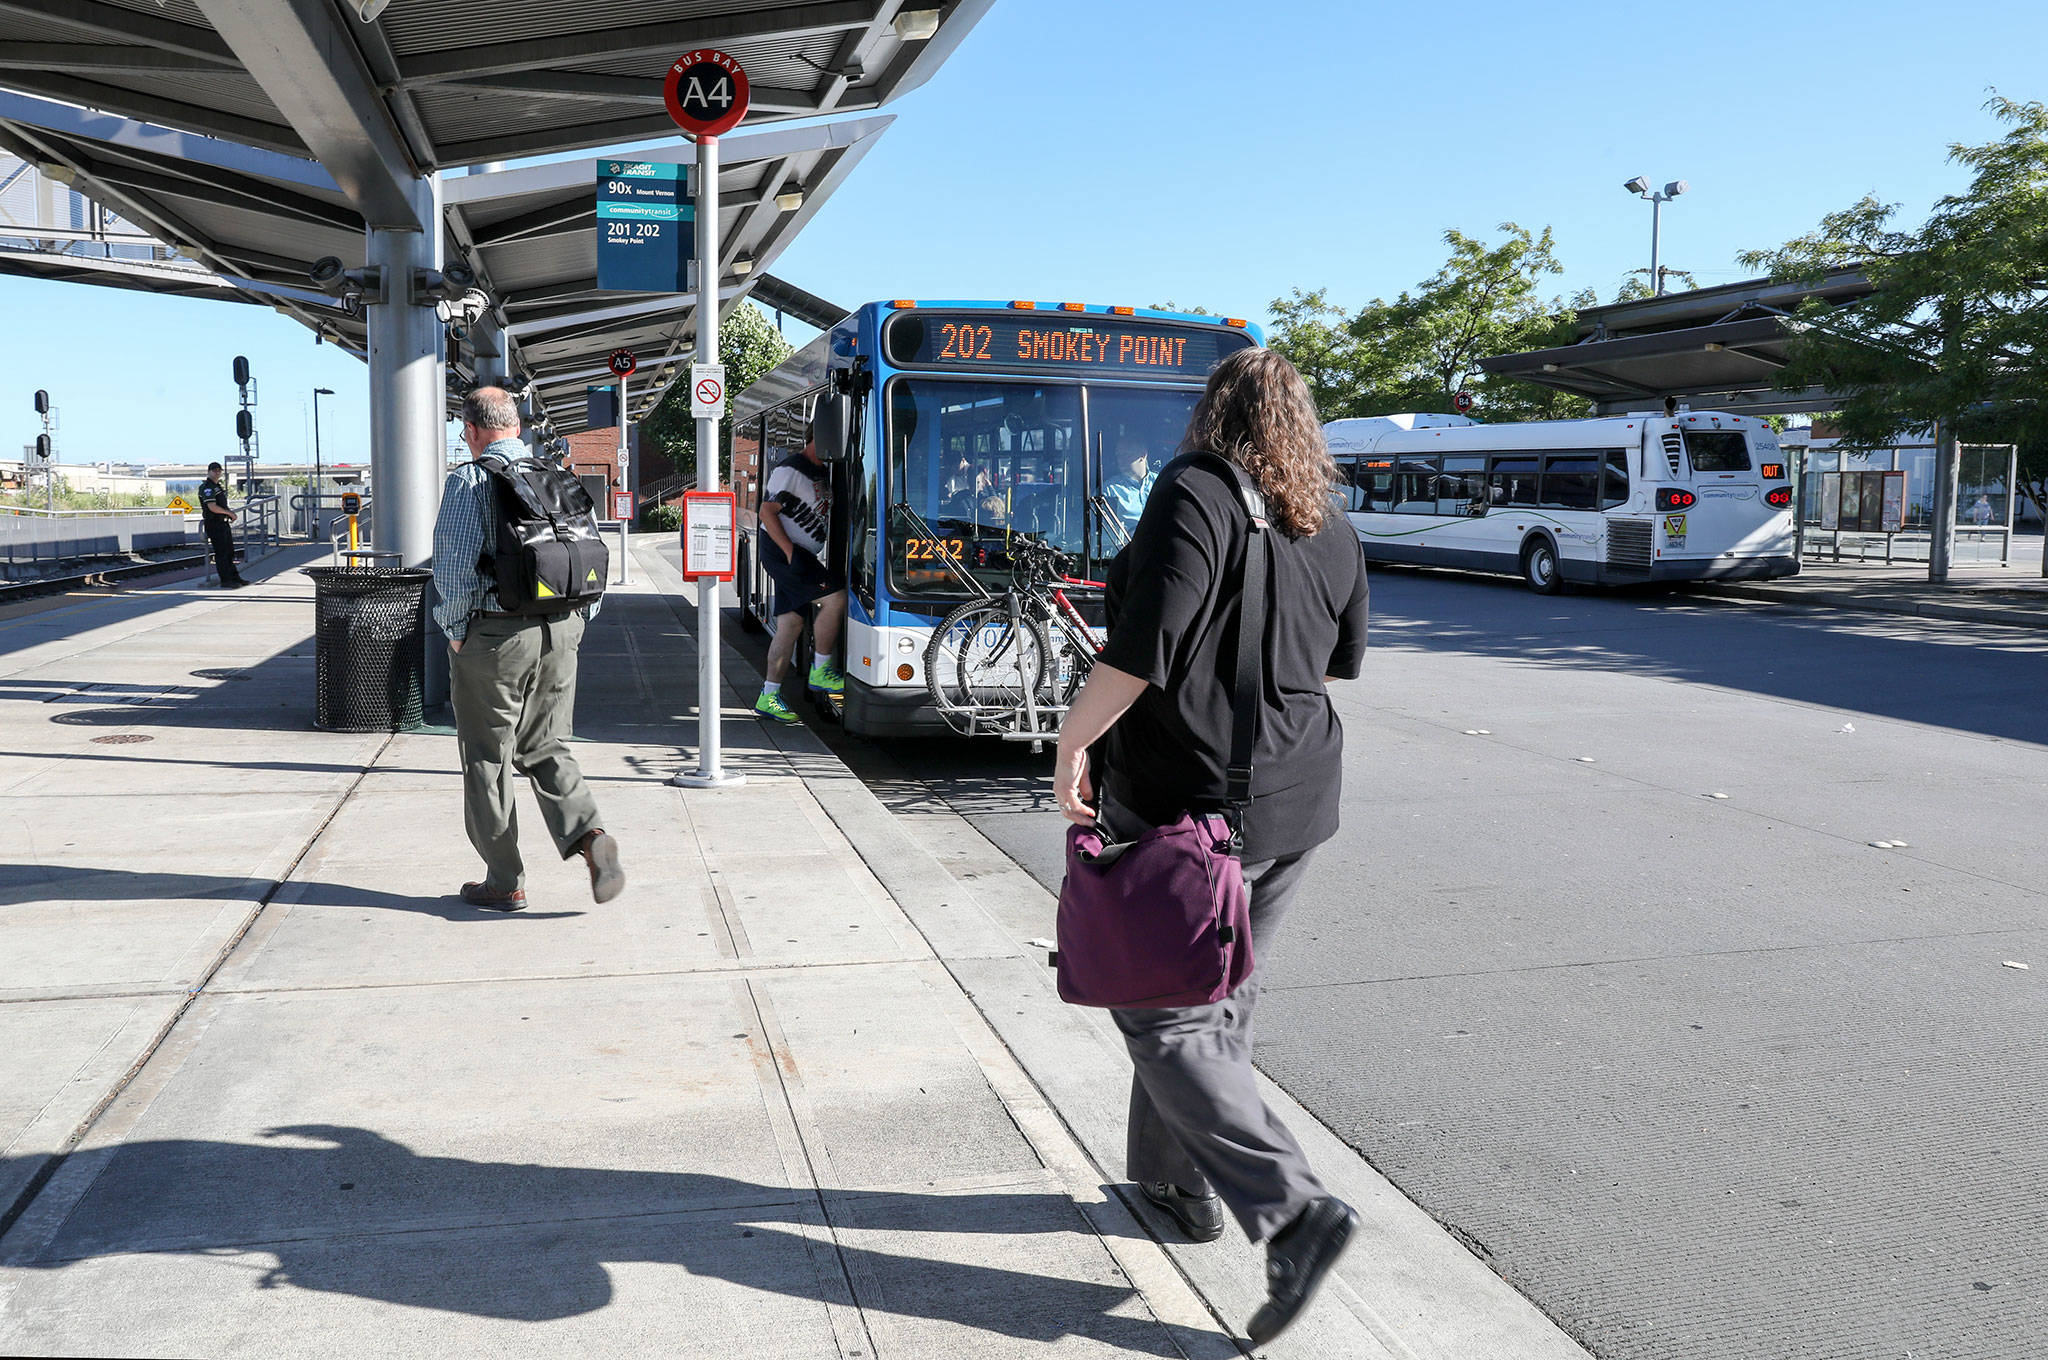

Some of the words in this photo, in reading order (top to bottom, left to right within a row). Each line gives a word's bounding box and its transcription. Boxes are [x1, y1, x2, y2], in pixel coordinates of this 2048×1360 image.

[674, 51, 702, 73] BUS
[713, 53, 741, 74] BAY
[682, 76, 732, 108] A4
[622, 169, 657, 177] TRANSIT
[623, 163, 653, 171] SKAGIT
[608, 181, 632, 194] 90x
[607, 222, 631, 236] 201
[636, 223, 660, 237] 202
[607, 237, 629, 245] Smokey
[940, 323, 992, 359] 202
[1017, 329, 1110, 362] SMOKEY
[1119, 335, 1187, 366] POINT
[614, 357, 631, 369] A5
[1763, 465, 1779, 477] OUT
